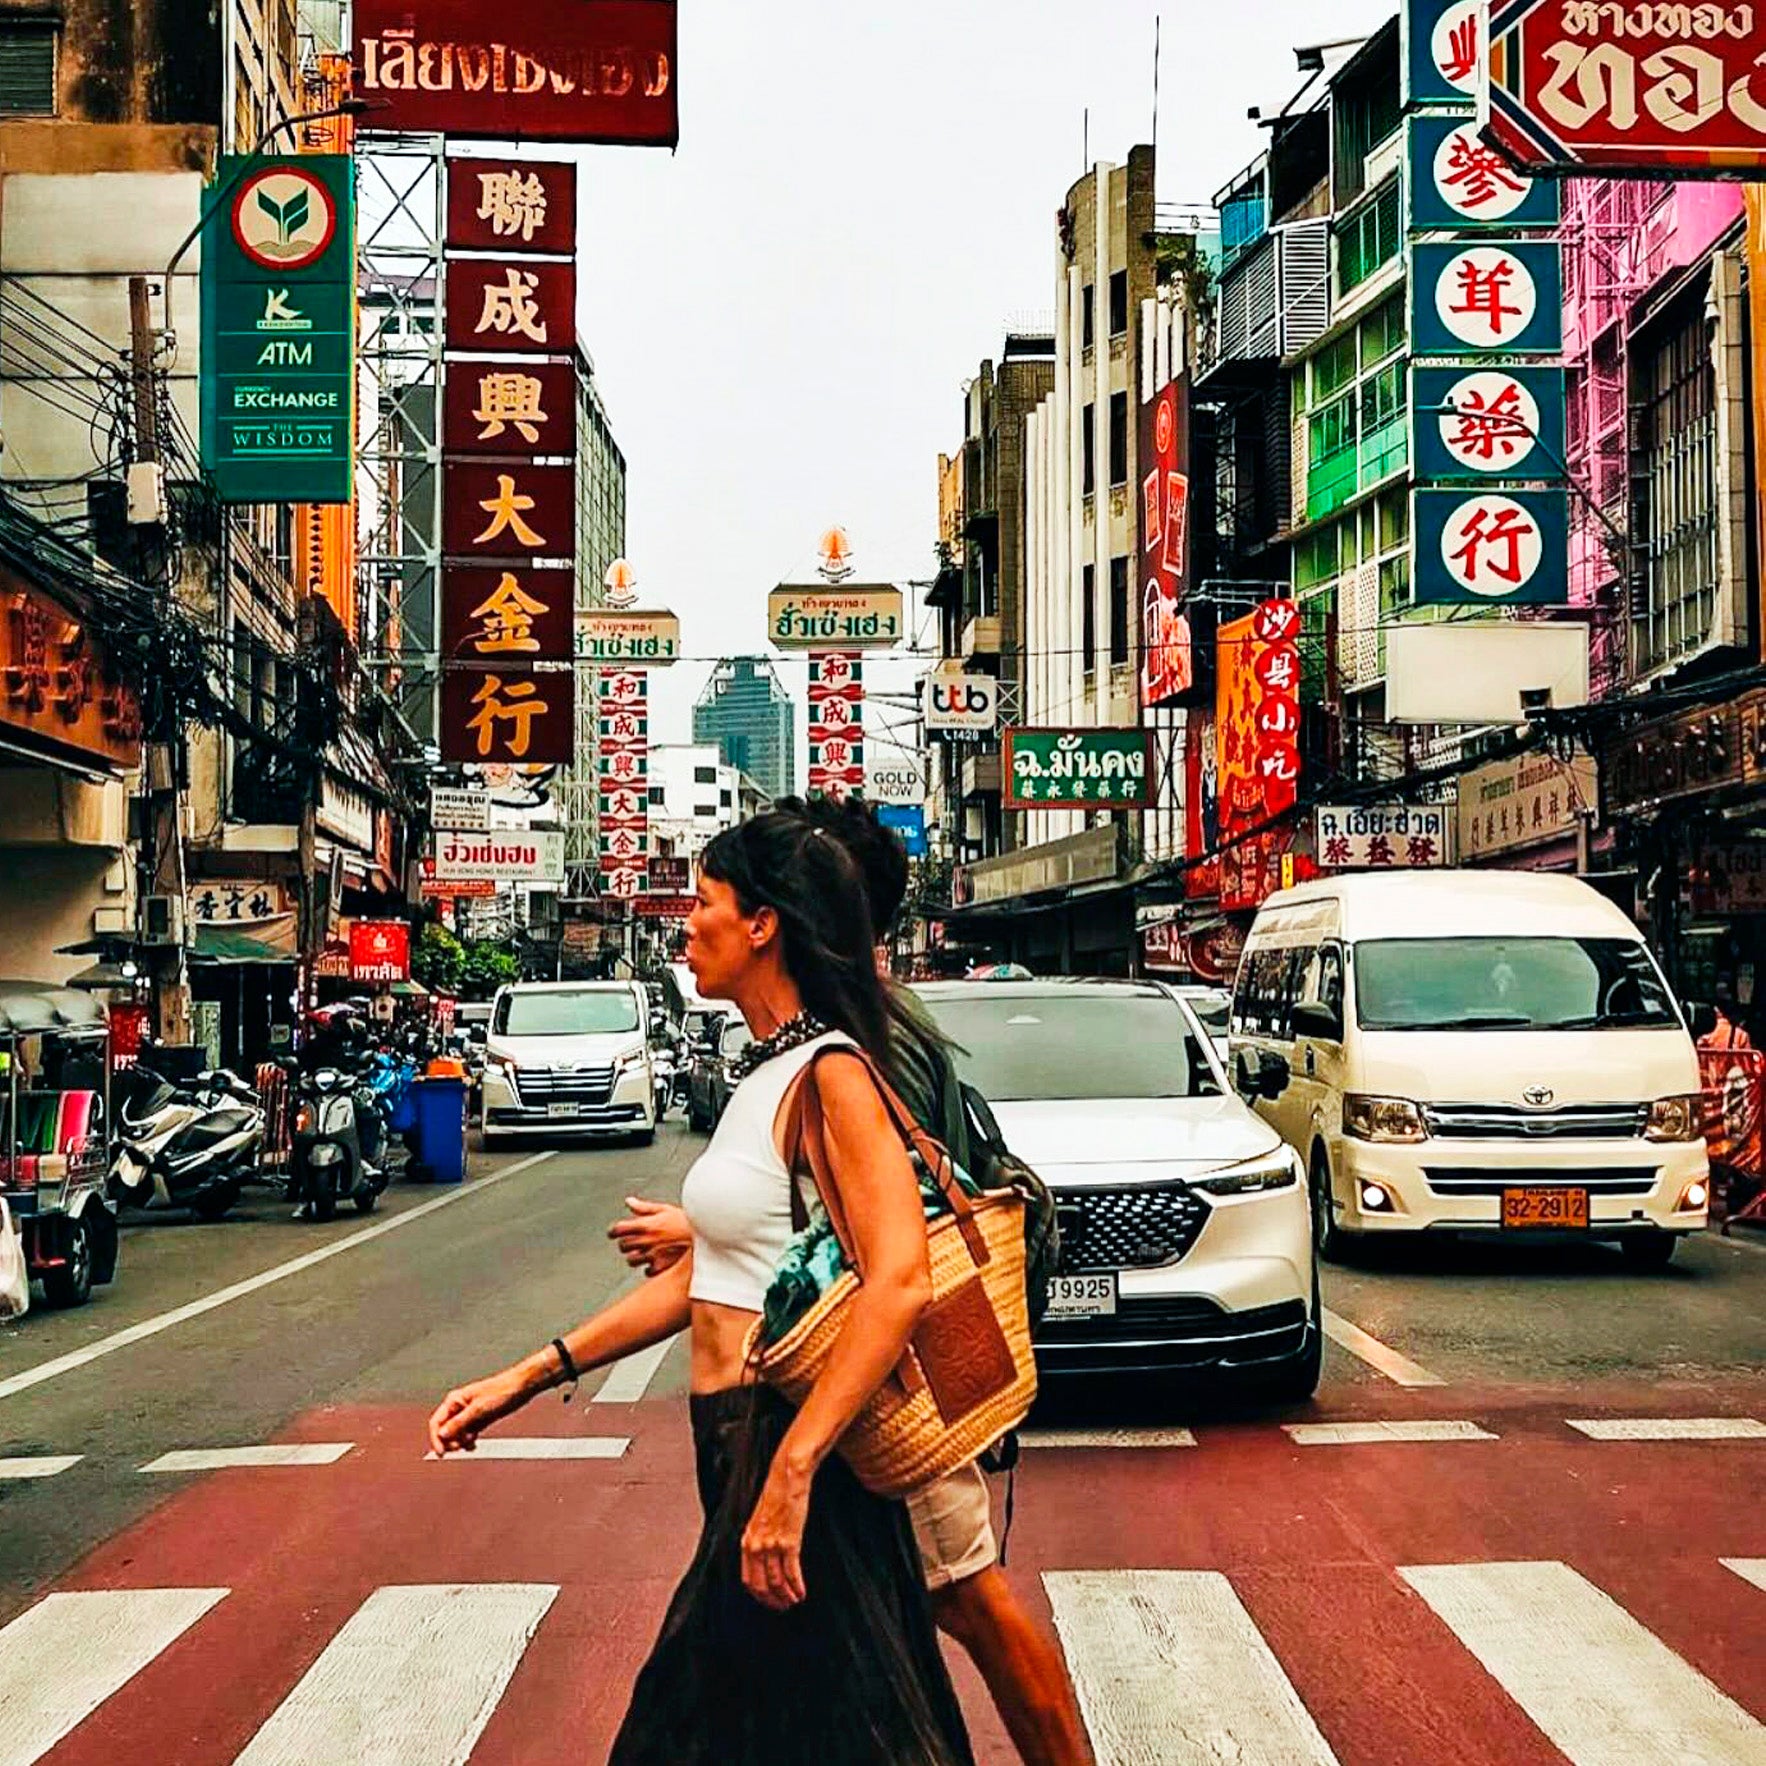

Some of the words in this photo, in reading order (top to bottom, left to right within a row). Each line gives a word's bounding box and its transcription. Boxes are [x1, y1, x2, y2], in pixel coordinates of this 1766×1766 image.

[257, 342, 312, 365] ATM
[234, 392, 338, 408] EXCHANGE
[233, 432, 333, 446] WISDOM
[466, 171, 550, 757] 聯成興大金行
[932, 684, 989, 713] ttb
[1261, 604, 1298, 780] 沙县小吃
[612, 677, 637, 896] 和成興大金行
[873, 772, 917, 785] GOLD
[879, 785, 913, 797] NOW
[1507, 1197, 1584, 1218] 32-2912
